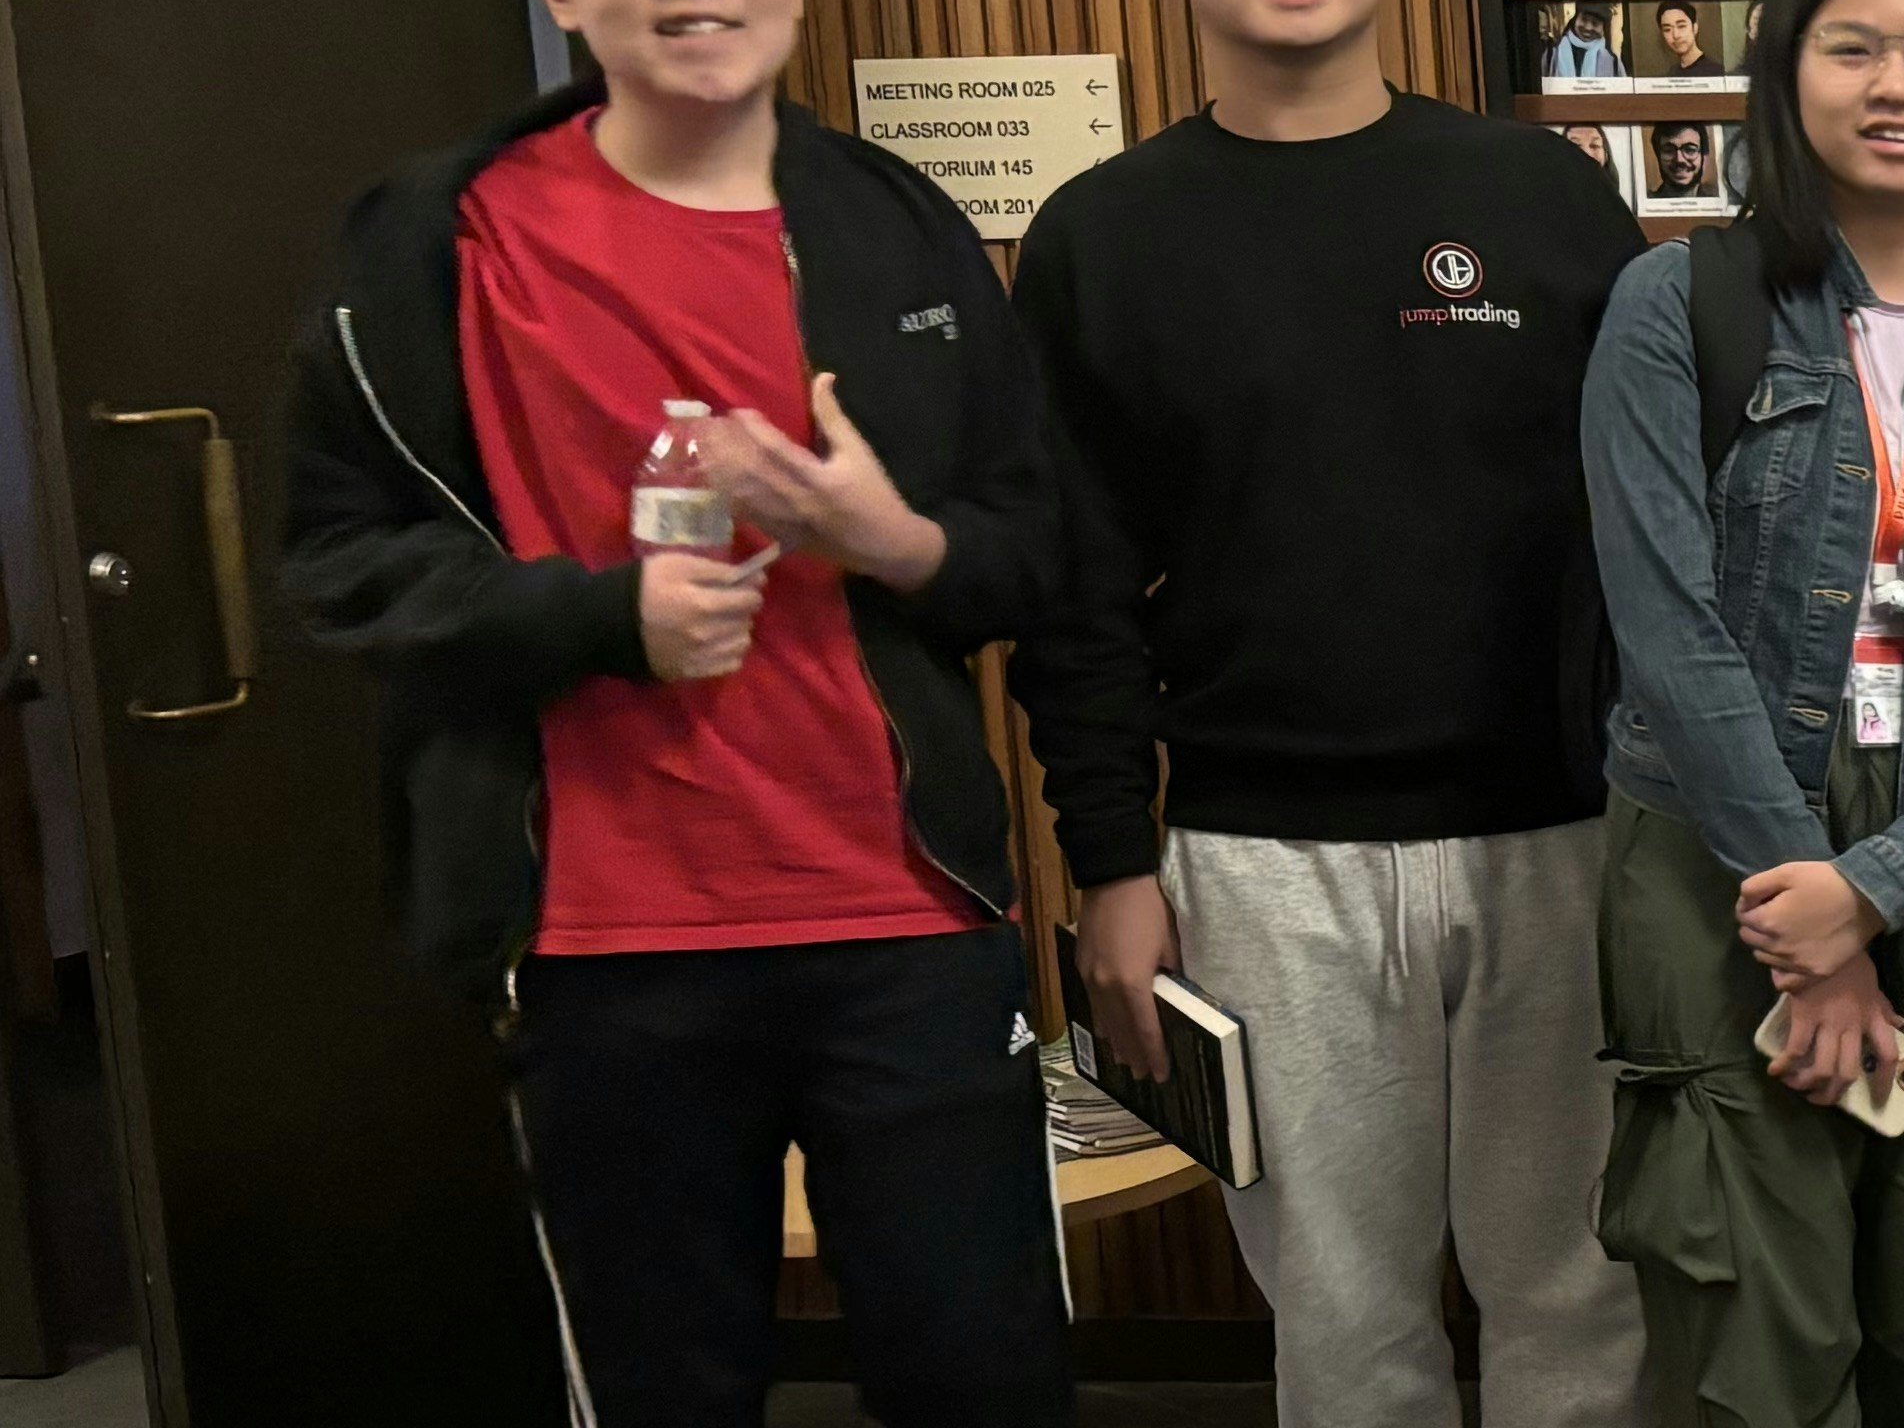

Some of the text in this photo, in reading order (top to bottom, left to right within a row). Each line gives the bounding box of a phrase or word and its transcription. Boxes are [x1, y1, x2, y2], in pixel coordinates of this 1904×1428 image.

[866, 80, 1056, 101] MEETING ROOM 025
[870, 120, 1031, 140] CLASSROOM 033
[1001, 159, 1033, 176] 145
[1004, 198, 1034, 214] 201
[1400, 300, 1521, 329] jump trading
